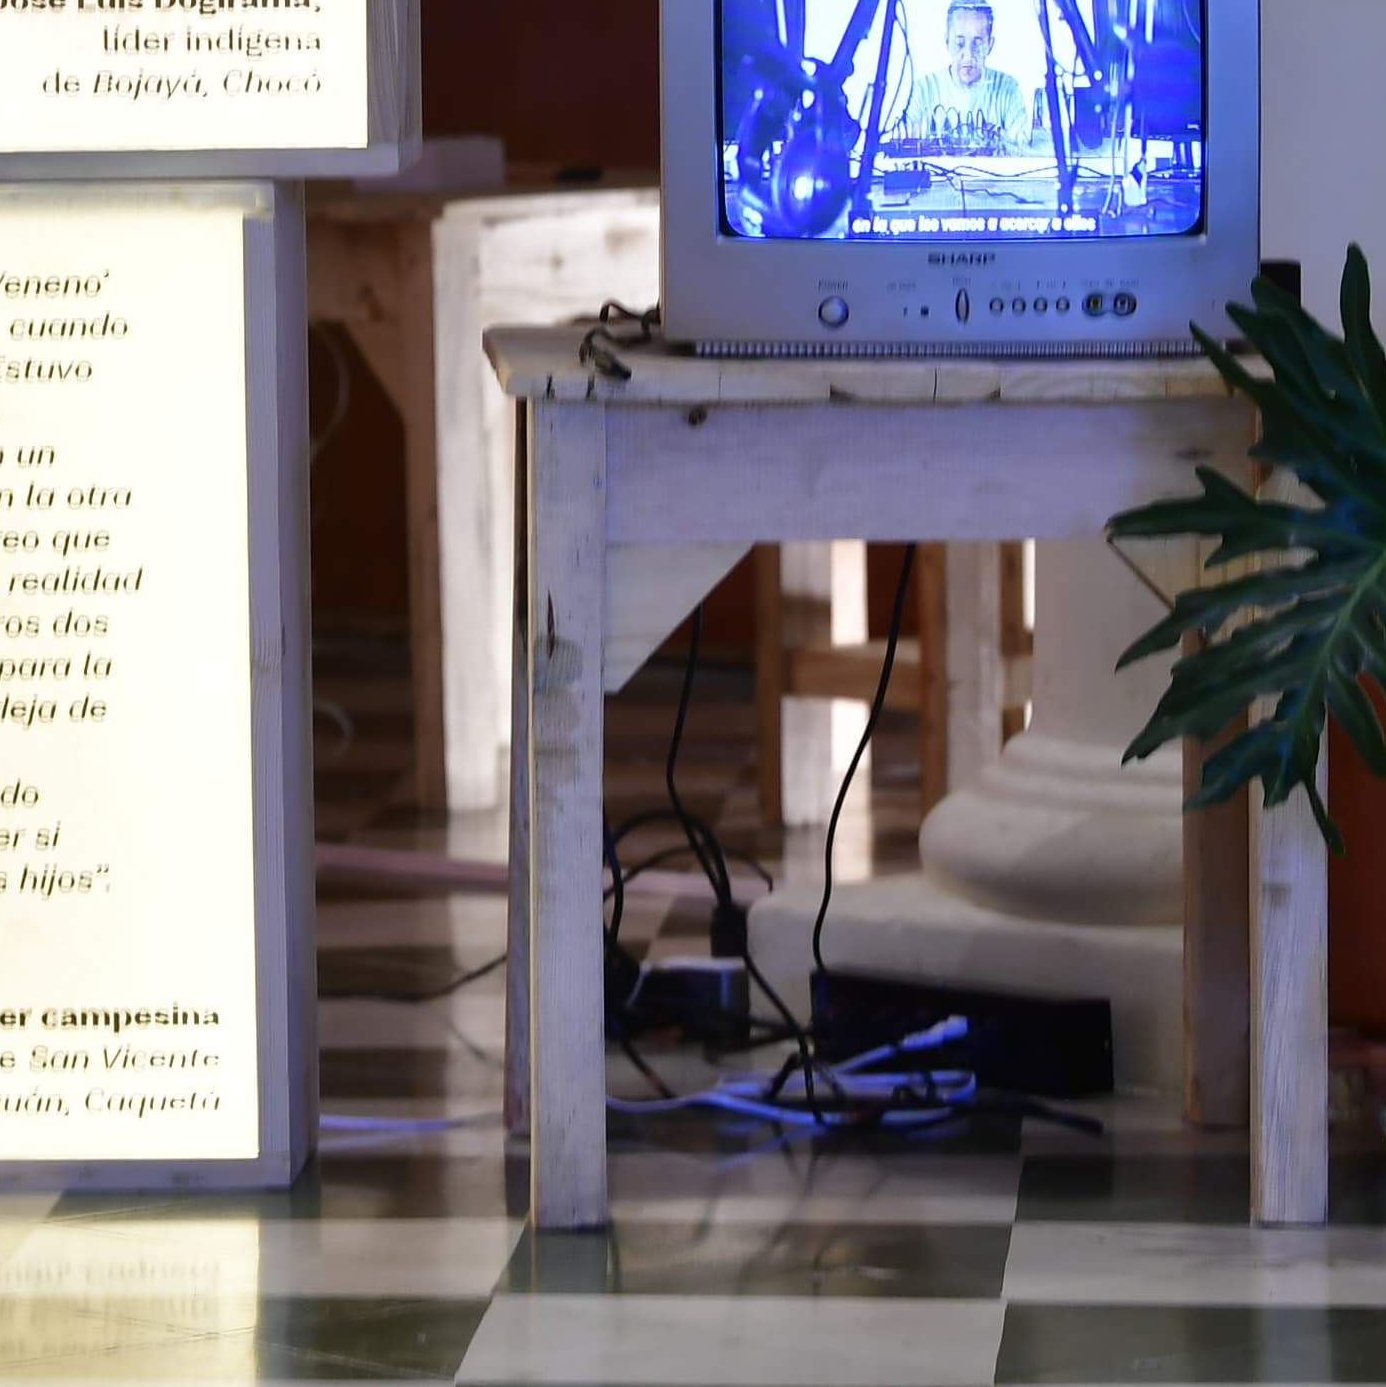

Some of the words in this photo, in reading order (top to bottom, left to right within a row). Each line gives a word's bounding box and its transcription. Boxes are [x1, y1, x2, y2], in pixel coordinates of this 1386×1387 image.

[102, 24, 175, 55] líder
[185, 25, 322, 58] indígena
[41, 68, 81, 96] de
[92, 68, 209, 102] Bojayá,
[222, 69, 322, 94] Chocó
[927, 252, 996, 266] SHARP
[8, 309, 131, 341] cuando
[16, 445, 56, 469] un
[25, 480, 56, 511] la
[66, 484, 133, 511] otra
[51, 529, 112, 560] que
[8, 565, 144, 596] realidad
[52, 607, 110, 638] dos
[82, 649, 114, 680] la
[68, 692, 108, 723] de
[40, 1001, 221, 1037] campesina
[28, 1045, 90, 1072] San
[102, 1044, 220, 1071] Vicente
